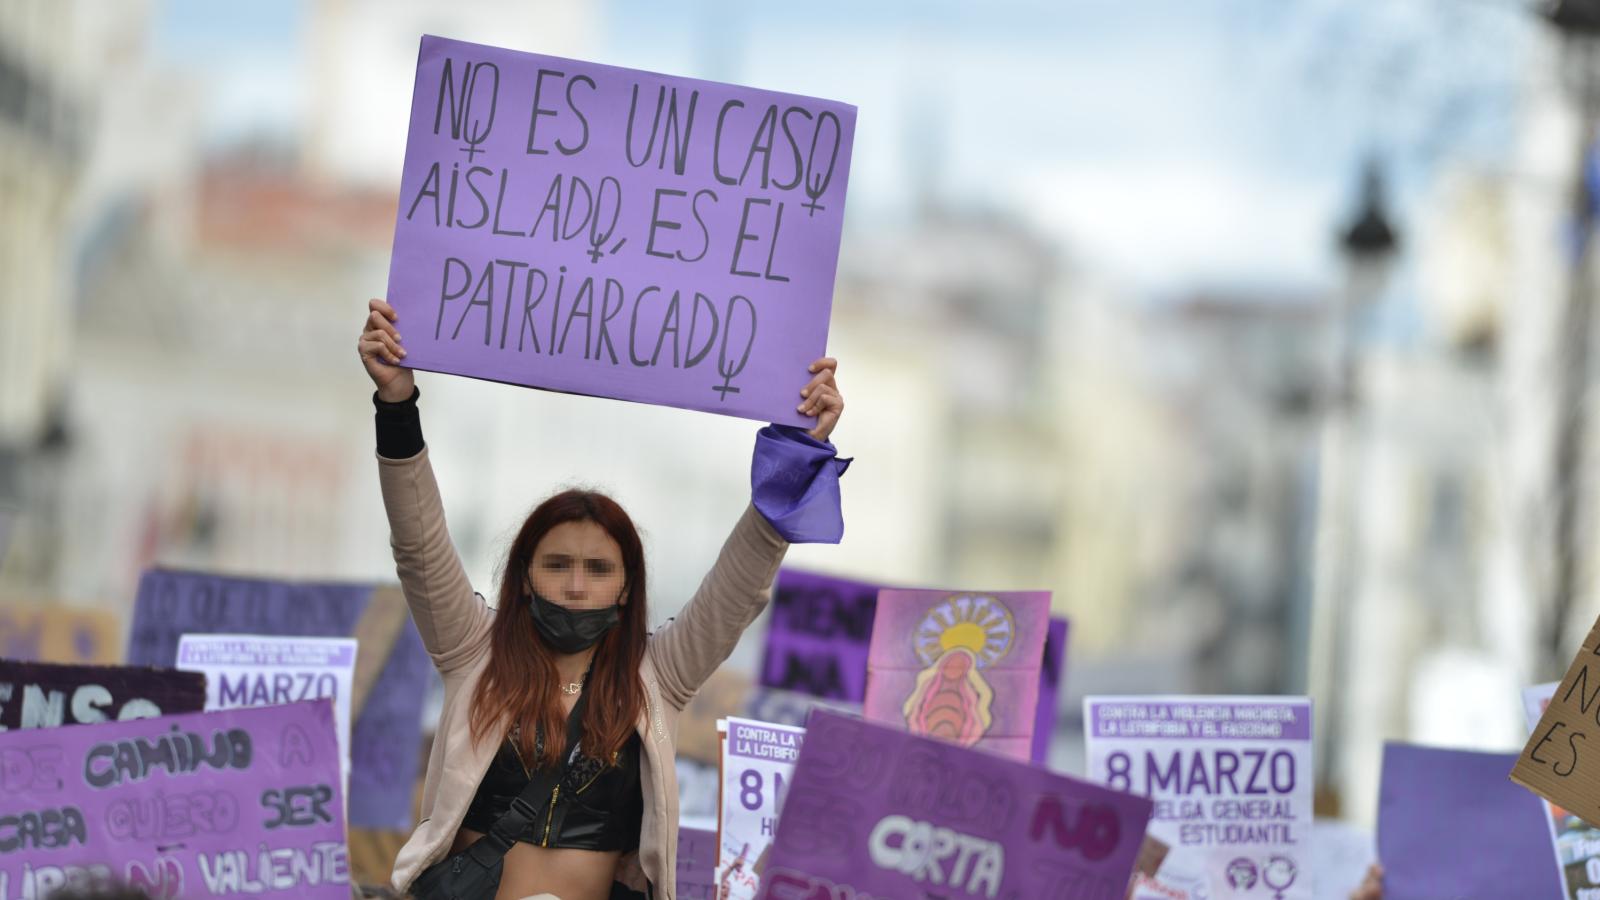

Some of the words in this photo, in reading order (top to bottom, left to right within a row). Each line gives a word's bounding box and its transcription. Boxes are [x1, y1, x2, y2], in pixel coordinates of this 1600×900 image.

[434, 58, 499, 162] NO
[526, 69, 596, 156] ES
[625, 83, 700, 176] UN
[713, 99, 841, 217] CASO
[646, 188, 718, 262] ES
[729, 198, 790, 282] EL
[434, 257, 757, 401] PATRIARCADO
[219, 673, 338, 706] MARZO
[85, 723, 253, 788] CAMINO
[281, 723, 314, 769] A
[737, 726, 777, 744] CONTRA
[780, 733, 796, 747] LA
[737, 740, 752, 754] LA
[1530, 721, 1586, 777] ES
[740, 769, 763, 811] 8
[1107, 752, 1131, 792] 8
[1146, 751, 1296, 796] MARZO
[261, 784, 334, 829] SER
[1028, 791, 1122, 861] NO
[1211, 801, 1297, 820] GENERAL
[868, 814, 1005, 898] CORTA
[1179, 823, 1297, 844] ESTUDIANTIL
[198, 842, 348, 896] VALIENTE
